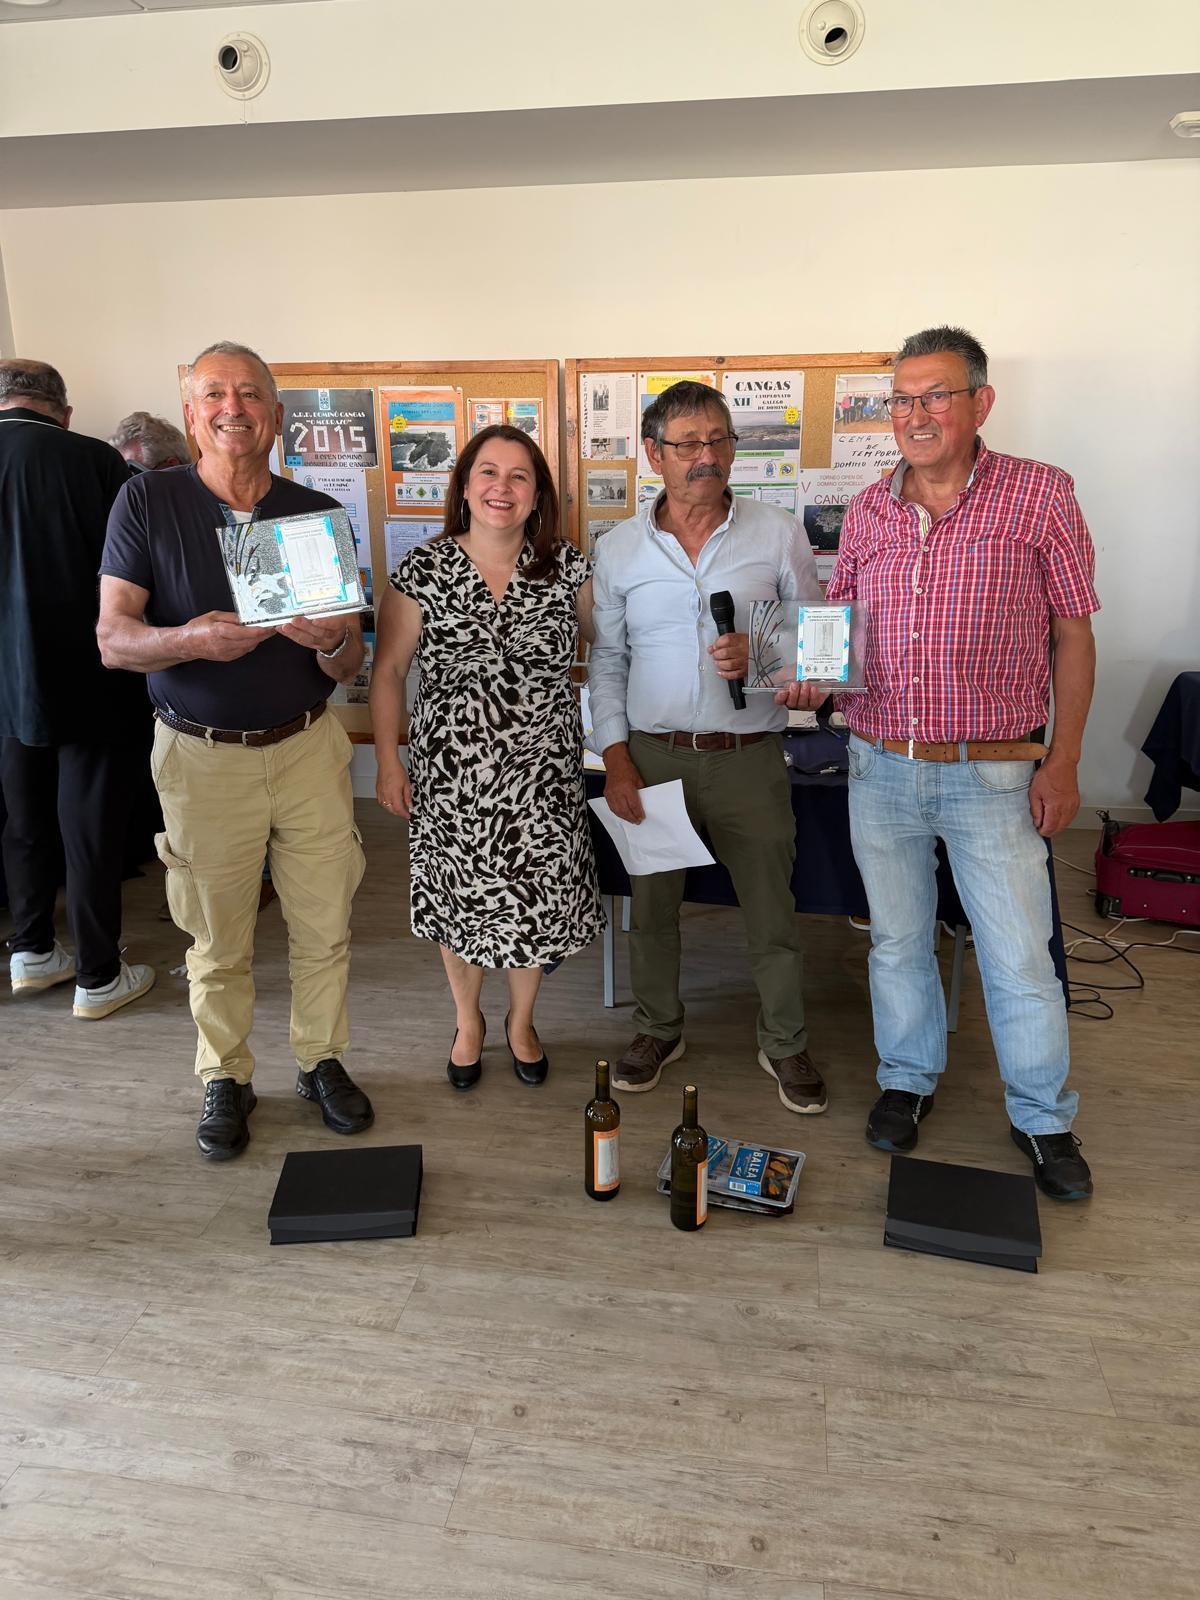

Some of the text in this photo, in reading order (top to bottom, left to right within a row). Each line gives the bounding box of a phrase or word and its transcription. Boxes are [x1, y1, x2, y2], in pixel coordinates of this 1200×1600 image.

[735, 380, 791, 392] CANGAS
[732, 397, 751, 407] XII
[289, 422, 367, 453] 2015
[801, 481, 811, 494] V
[746, 1151, 764, 1178] BALEA
